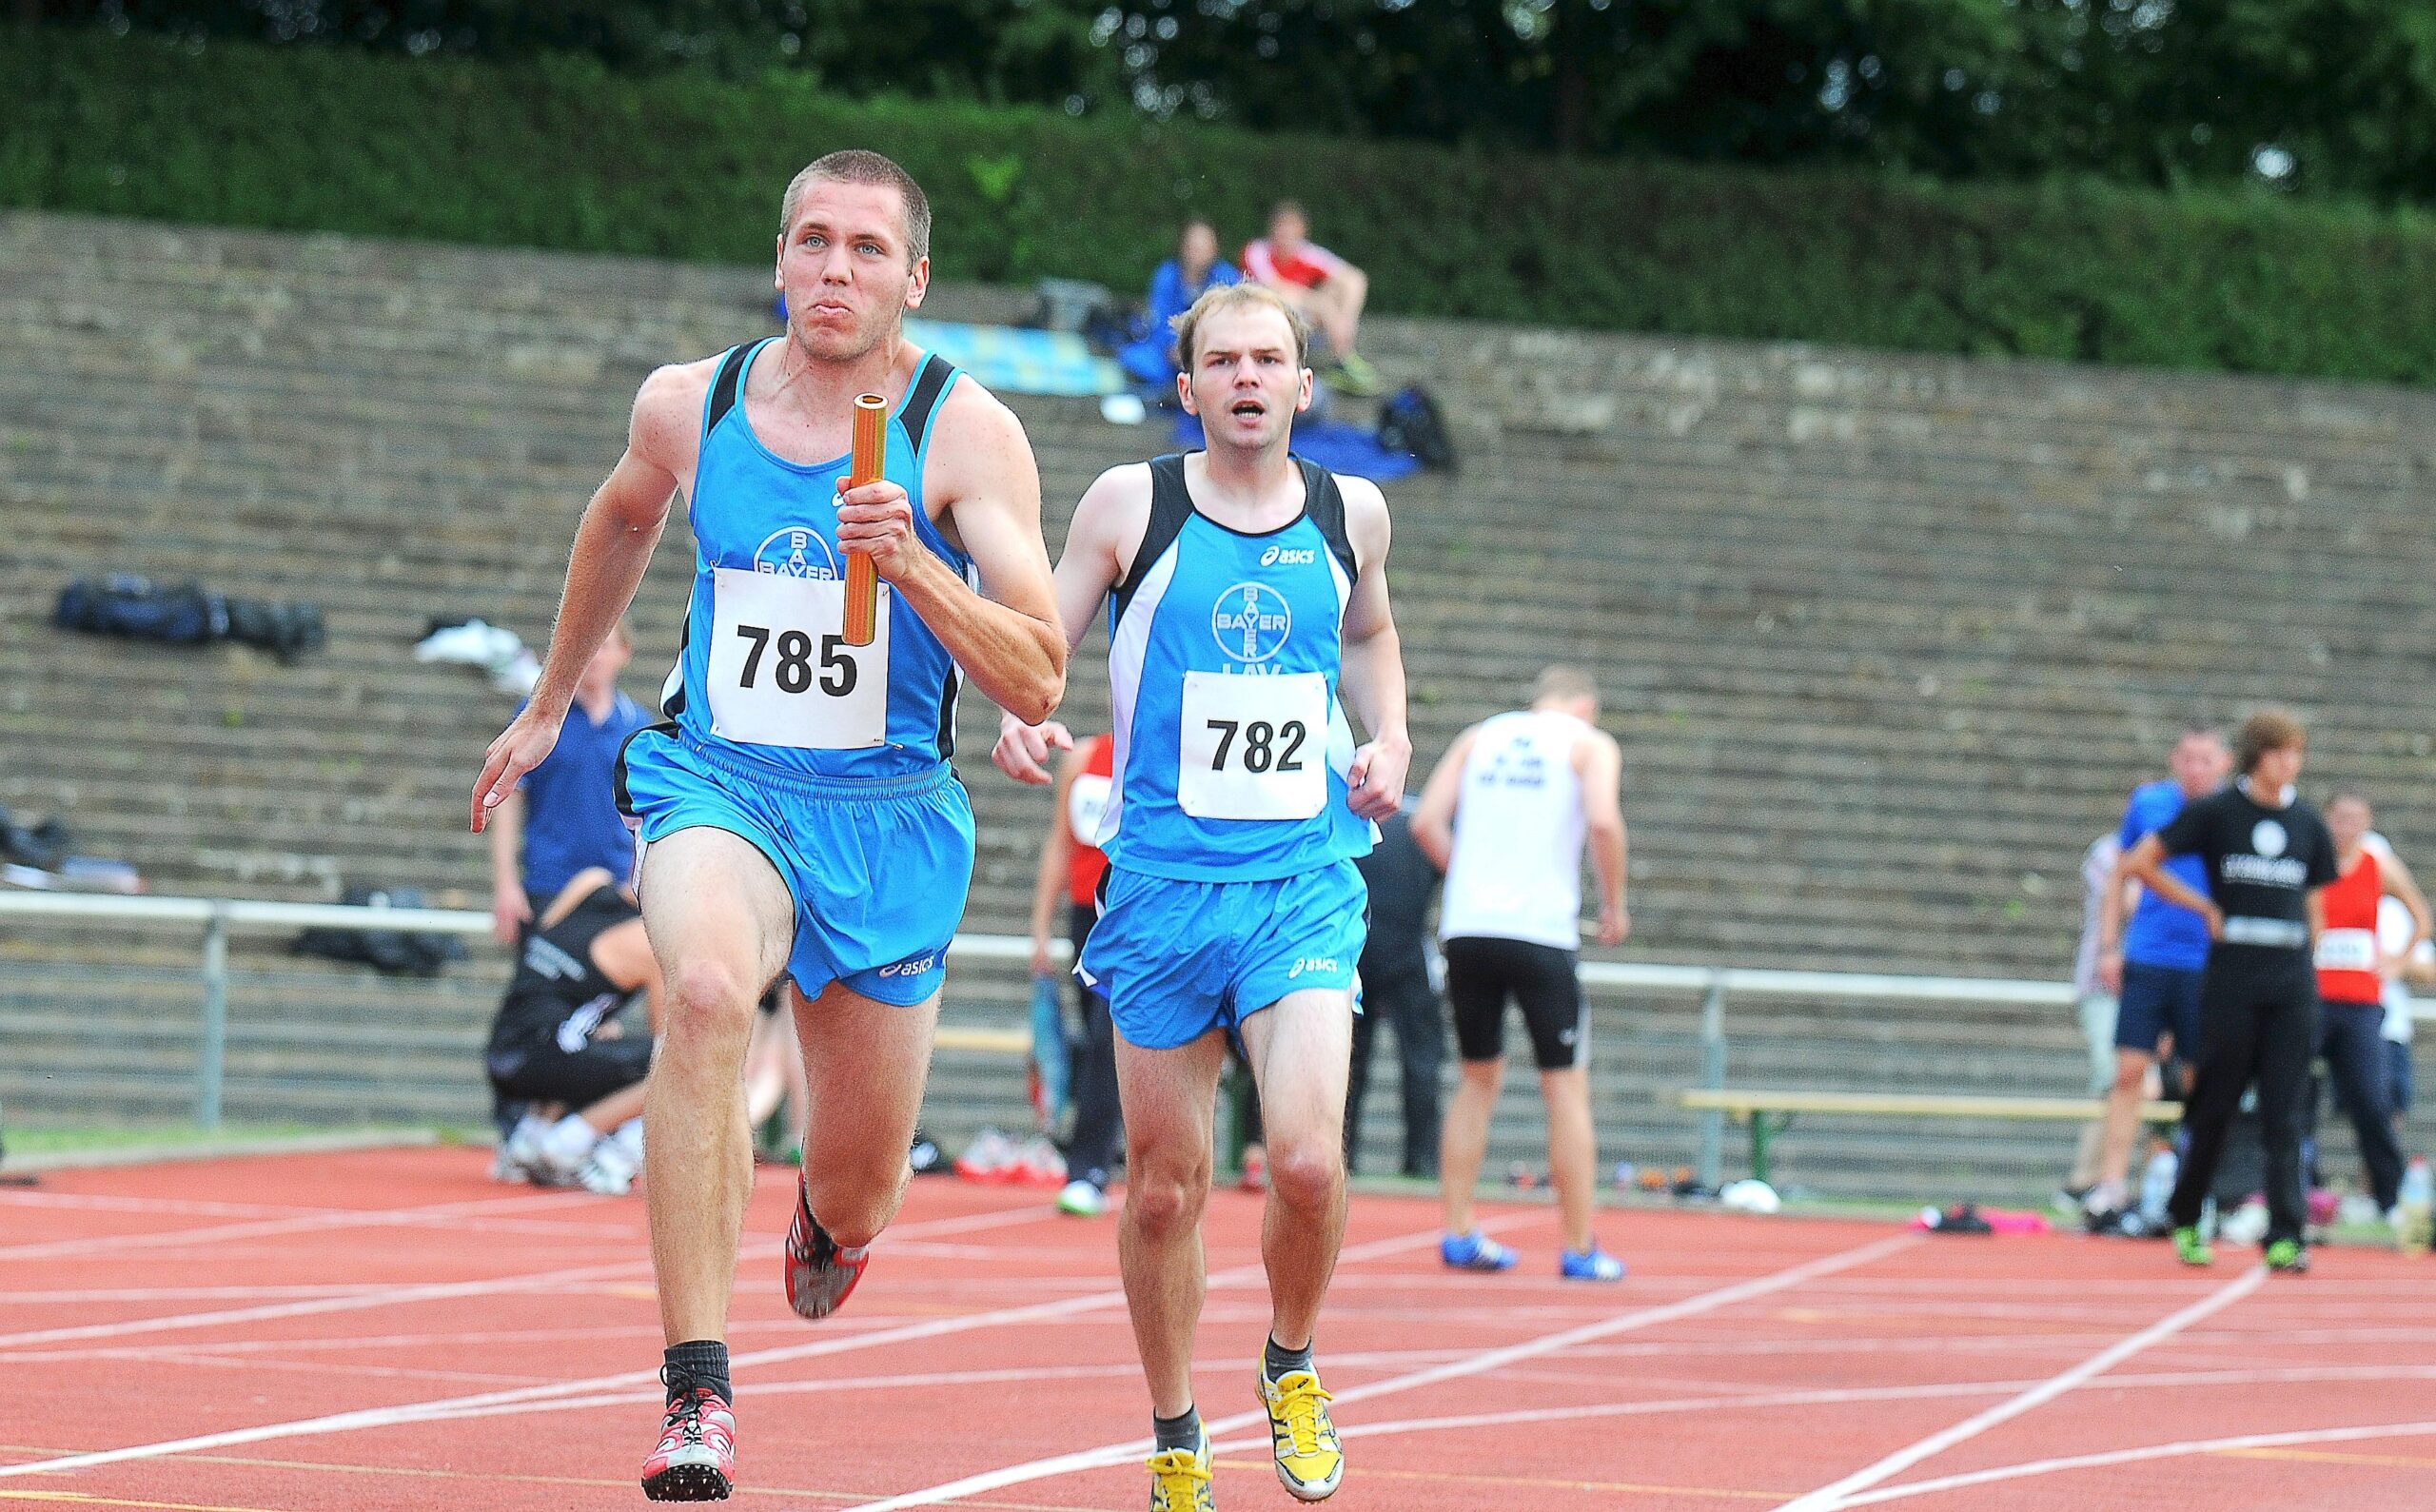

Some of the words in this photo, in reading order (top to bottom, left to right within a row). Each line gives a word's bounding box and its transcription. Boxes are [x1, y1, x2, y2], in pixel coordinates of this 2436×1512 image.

[1278, 549, 1315, 564] asics
[1217, 614, 1286, 630] BAYER
[737, 624, 857, 697] 785
[1208, 719, 1306, 773] 782
[900, 955, 934, 976] asics
